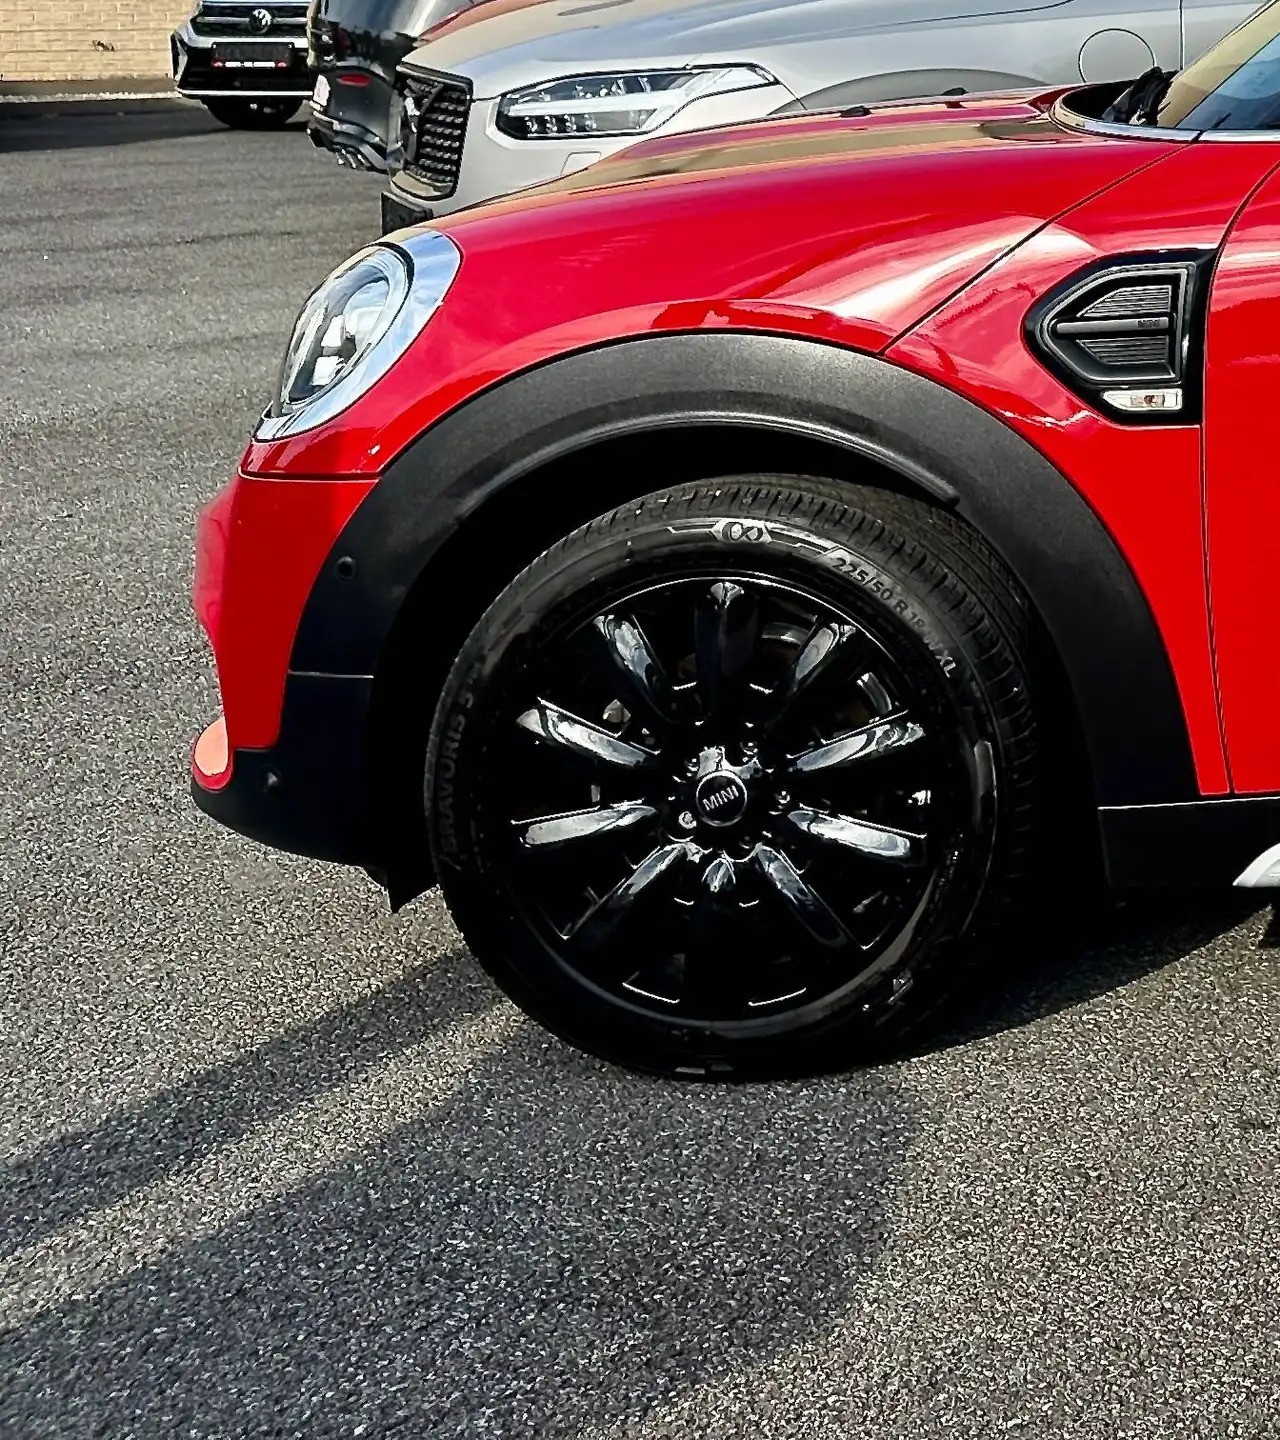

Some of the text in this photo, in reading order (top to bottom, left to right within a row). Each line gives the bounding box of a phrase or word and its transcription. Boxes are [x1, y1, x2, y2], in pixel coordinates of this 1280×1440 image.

[832, 557, 893, 601] 225/50
[892, 599, 909, 615] R
[935, 649, 957, 678] XL
[702, 784, 739, 811] MINI
